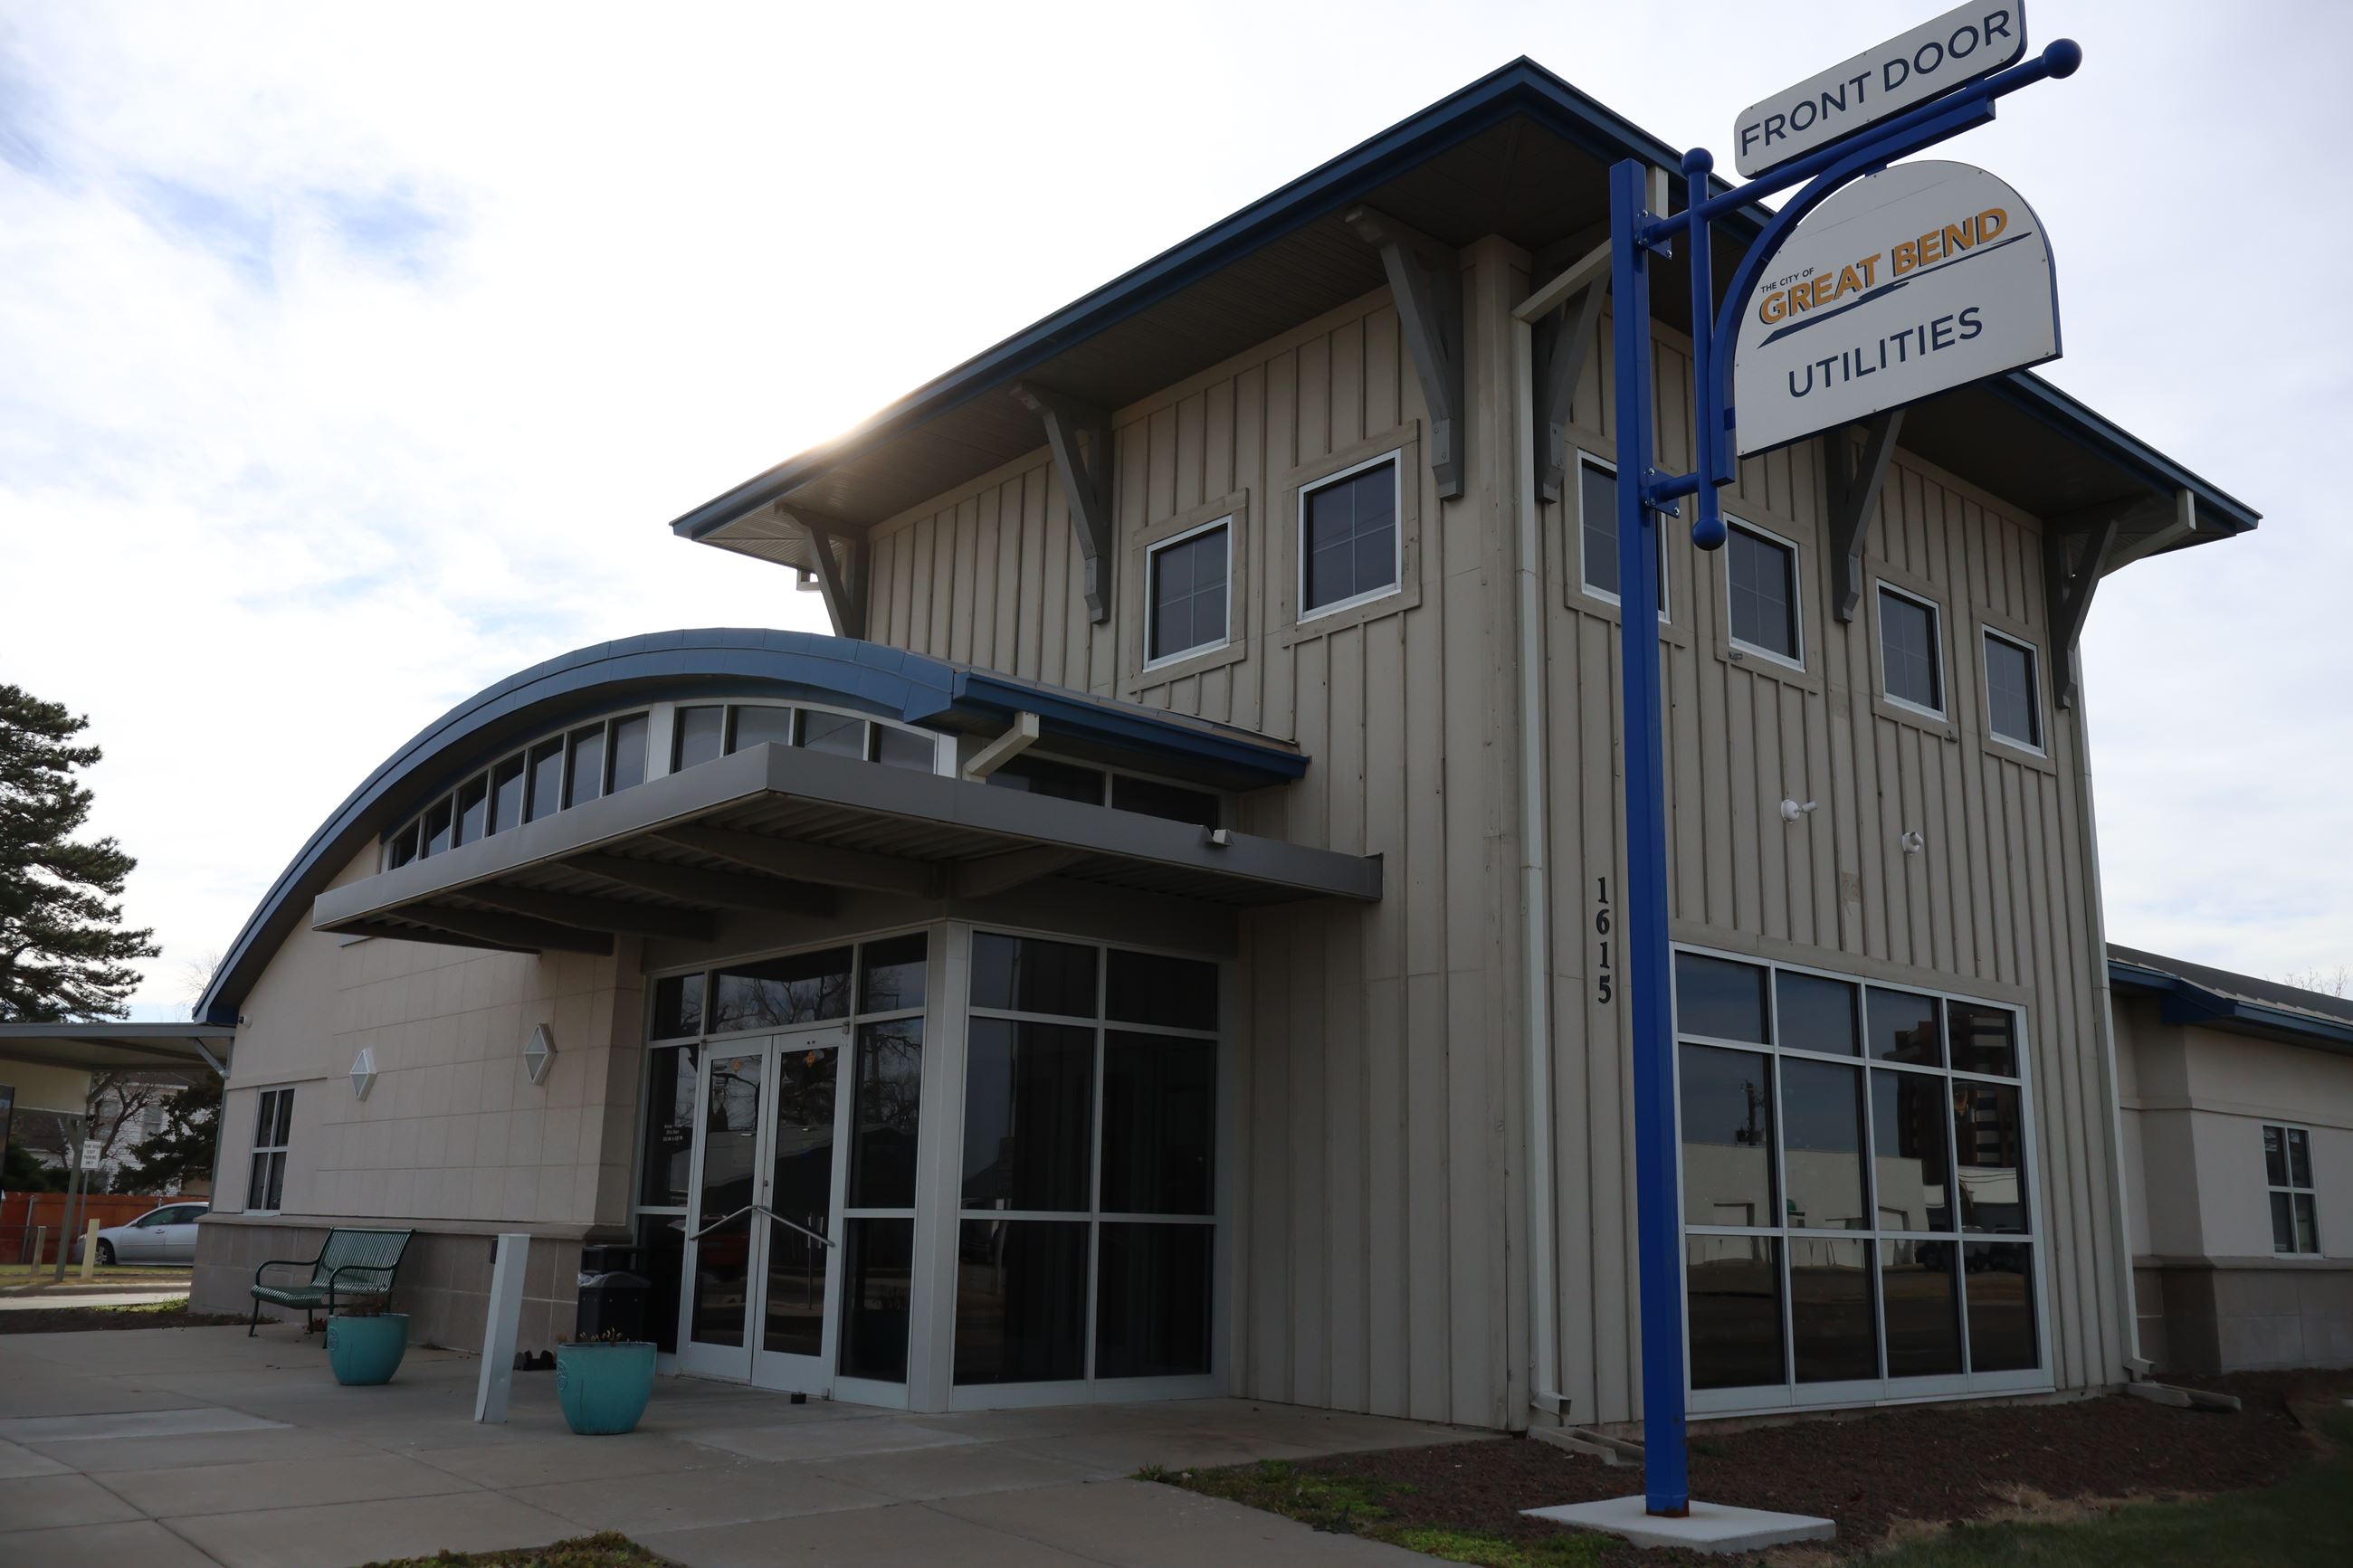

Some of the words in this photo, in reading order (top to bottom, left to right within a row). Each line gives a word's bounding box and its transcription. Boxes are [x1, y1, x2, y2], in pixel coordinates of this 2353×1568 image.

[1741, 71, 1872, 157] FRONT
[1883, 9, 2012, 92] DOOR
[1759, 253, 1881, 325] GREAT
[1891, 207, 2008, 277] BEND
[1760, 281, 1777, 293] THE
[1779, 272, 1799, 287] CITY
[1802, 267, 1815, 277] OF
[1788, 307, 1983, 398] UTILITIES
[1596, 877, 1612, 1003] 1615
